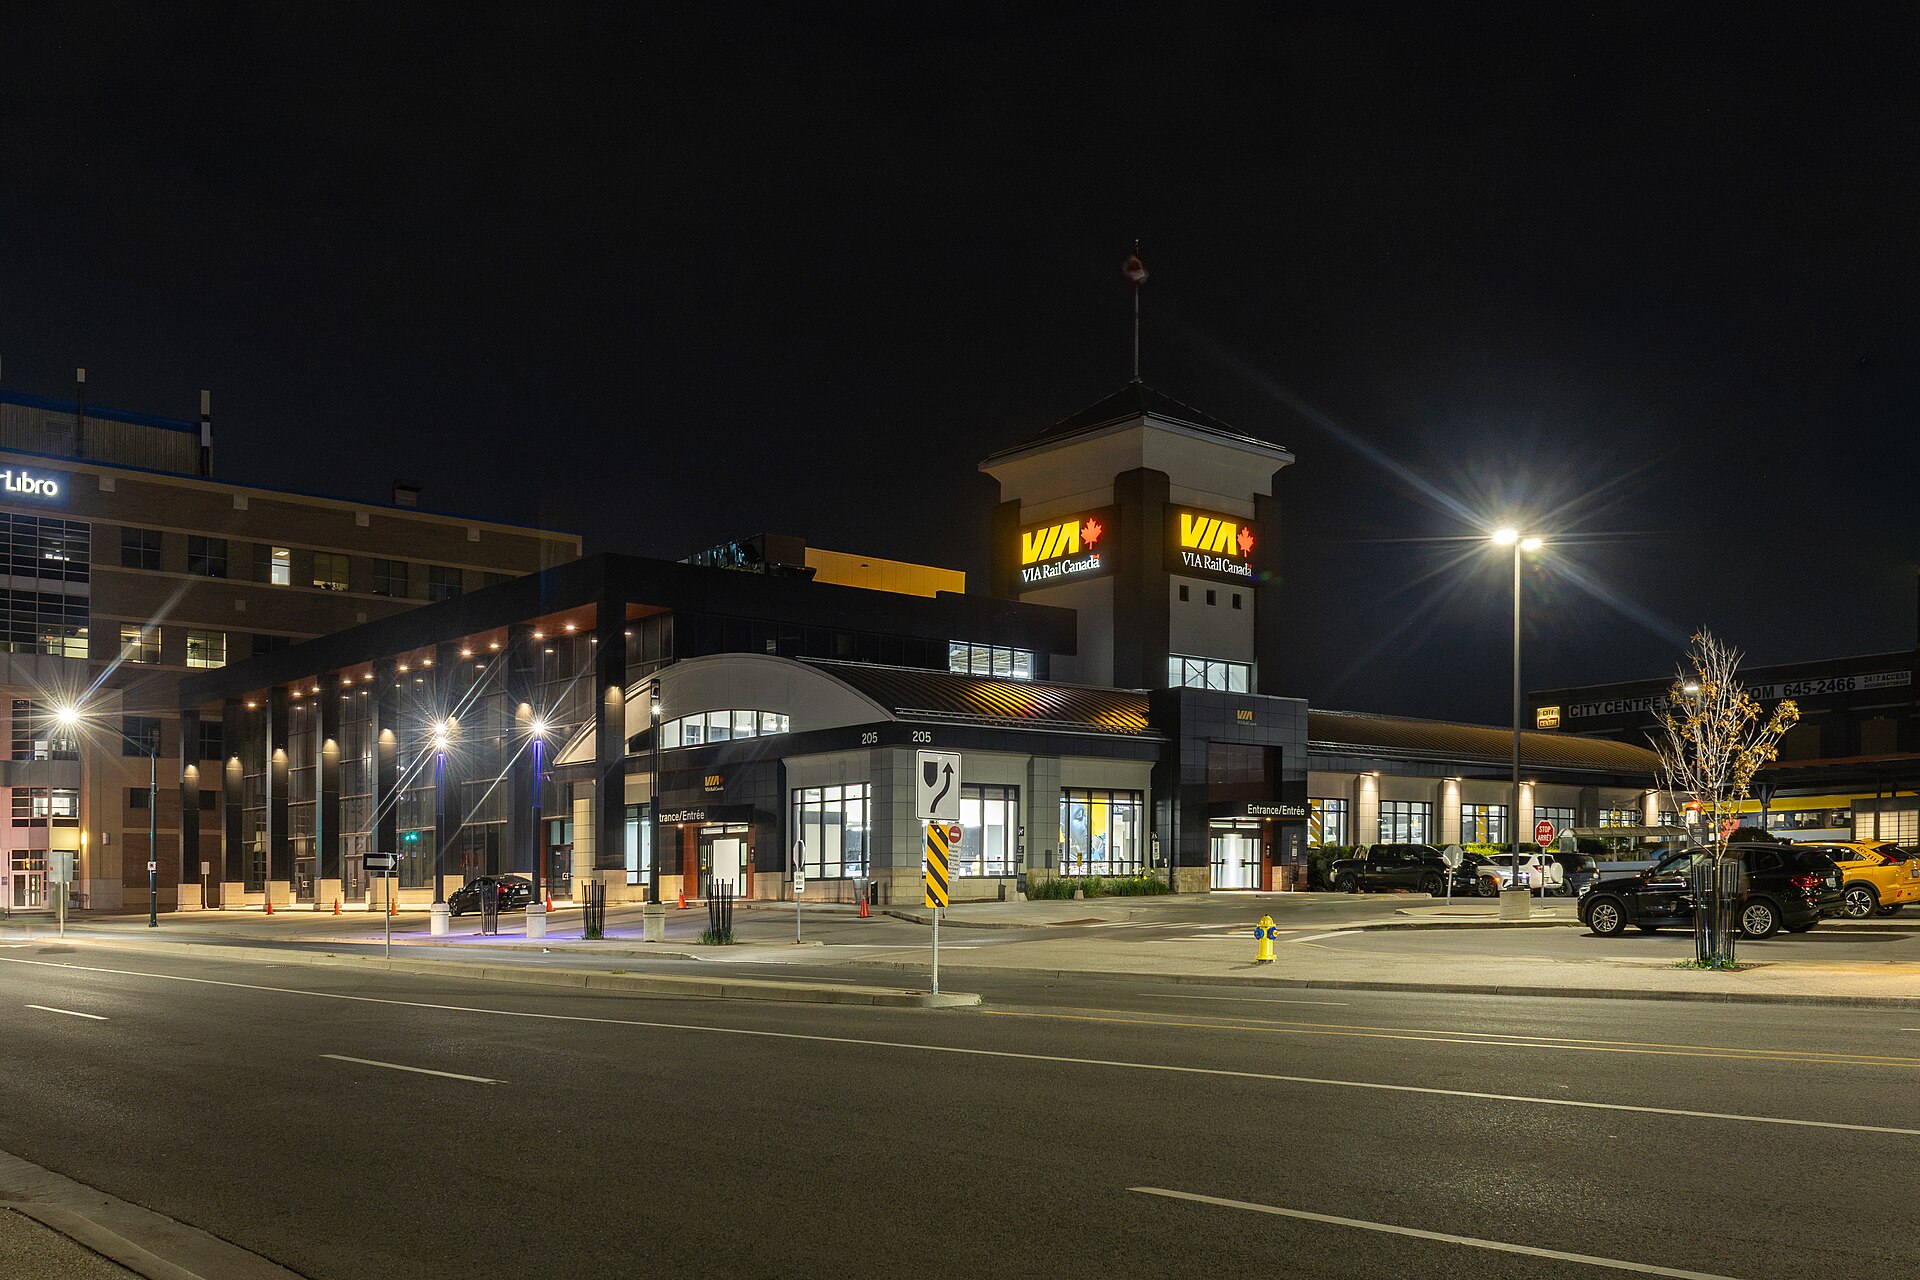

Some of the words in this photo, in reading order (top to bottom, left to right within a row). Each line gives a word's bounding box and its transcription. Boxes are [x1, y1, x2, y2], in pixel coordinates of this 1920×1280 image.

[1181, 513, 1237, 555] VIA
[1022, 520, 1080, 565] VIA
[1022, 567, 1042, 583] VIA
[1043, 562, 1062, 579] Rail
[1062, 554, 1100, 574] Canada
[1181, 551, 1203, 568] VIA
[1203, 554, 1222, 571] Rail
[1222, 558, 1252, 576] Canada
[1881, 672, 1910, 681] ACCESS
[1783, 678, 1856, 697] 645-2466
[1570, 704, 1602, 717] CITY
[1604, 697, 1662, 714] CENTRE
[1237, 710, 1252, 720] VIA
[861, 732, 878, 745] 205
[912, 730, 932, 743] 205
[705, 776, 719, 786] VIA
[659, 810, 705, 822] trance/Entrée
[1247, 803, 1305, 816] Entrance/Entrée
